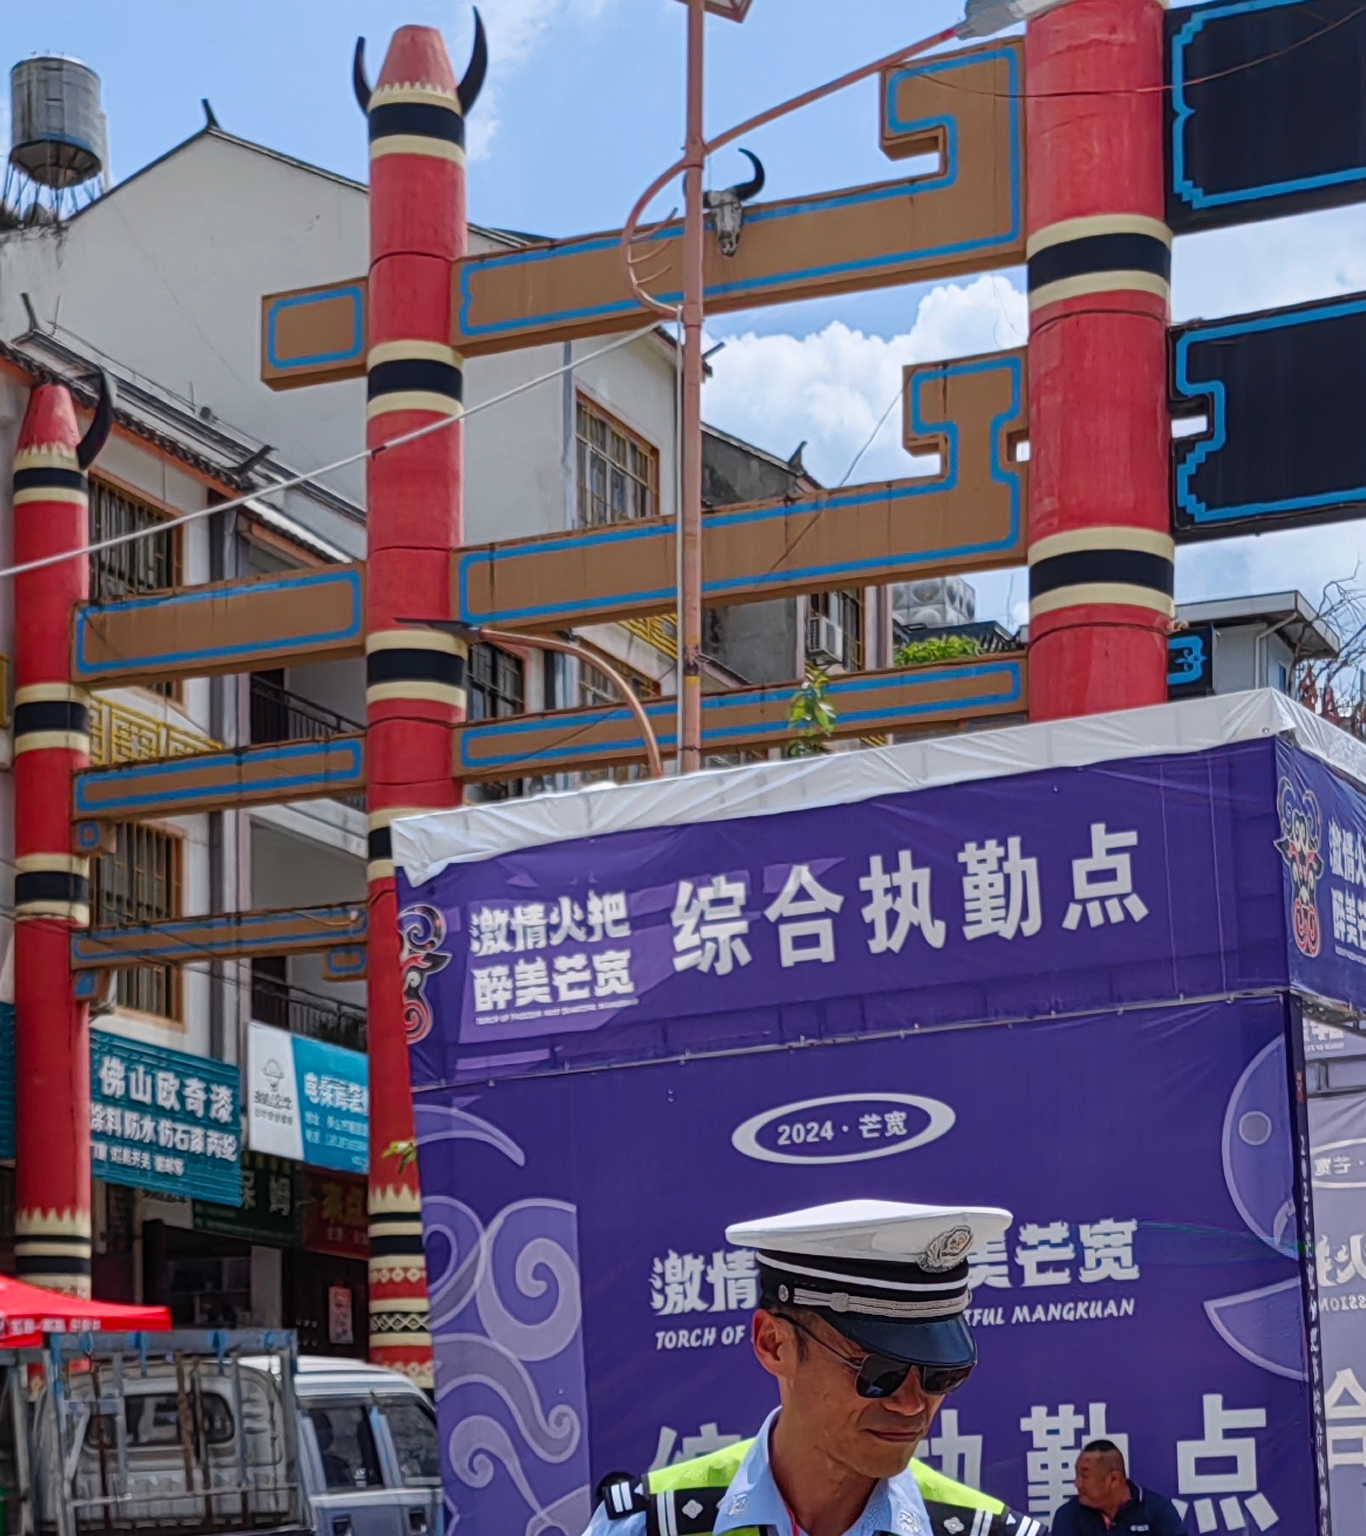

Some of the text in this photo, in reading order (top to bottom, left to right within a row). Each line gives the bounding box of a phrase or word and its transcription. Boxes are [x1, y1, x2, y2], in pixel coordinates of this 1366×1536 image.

[469, 890, 632, 957] 激情火把
[670, 822, 1150, 977] 综合执勤点
[471, 950, 634, 1012] 醉美芒宽
[655, 1326, 716, 1350] TORCH
[721, 1325, 746, 1346] OF
[1011, 1299, 1135, 1325] MANGKUAN
